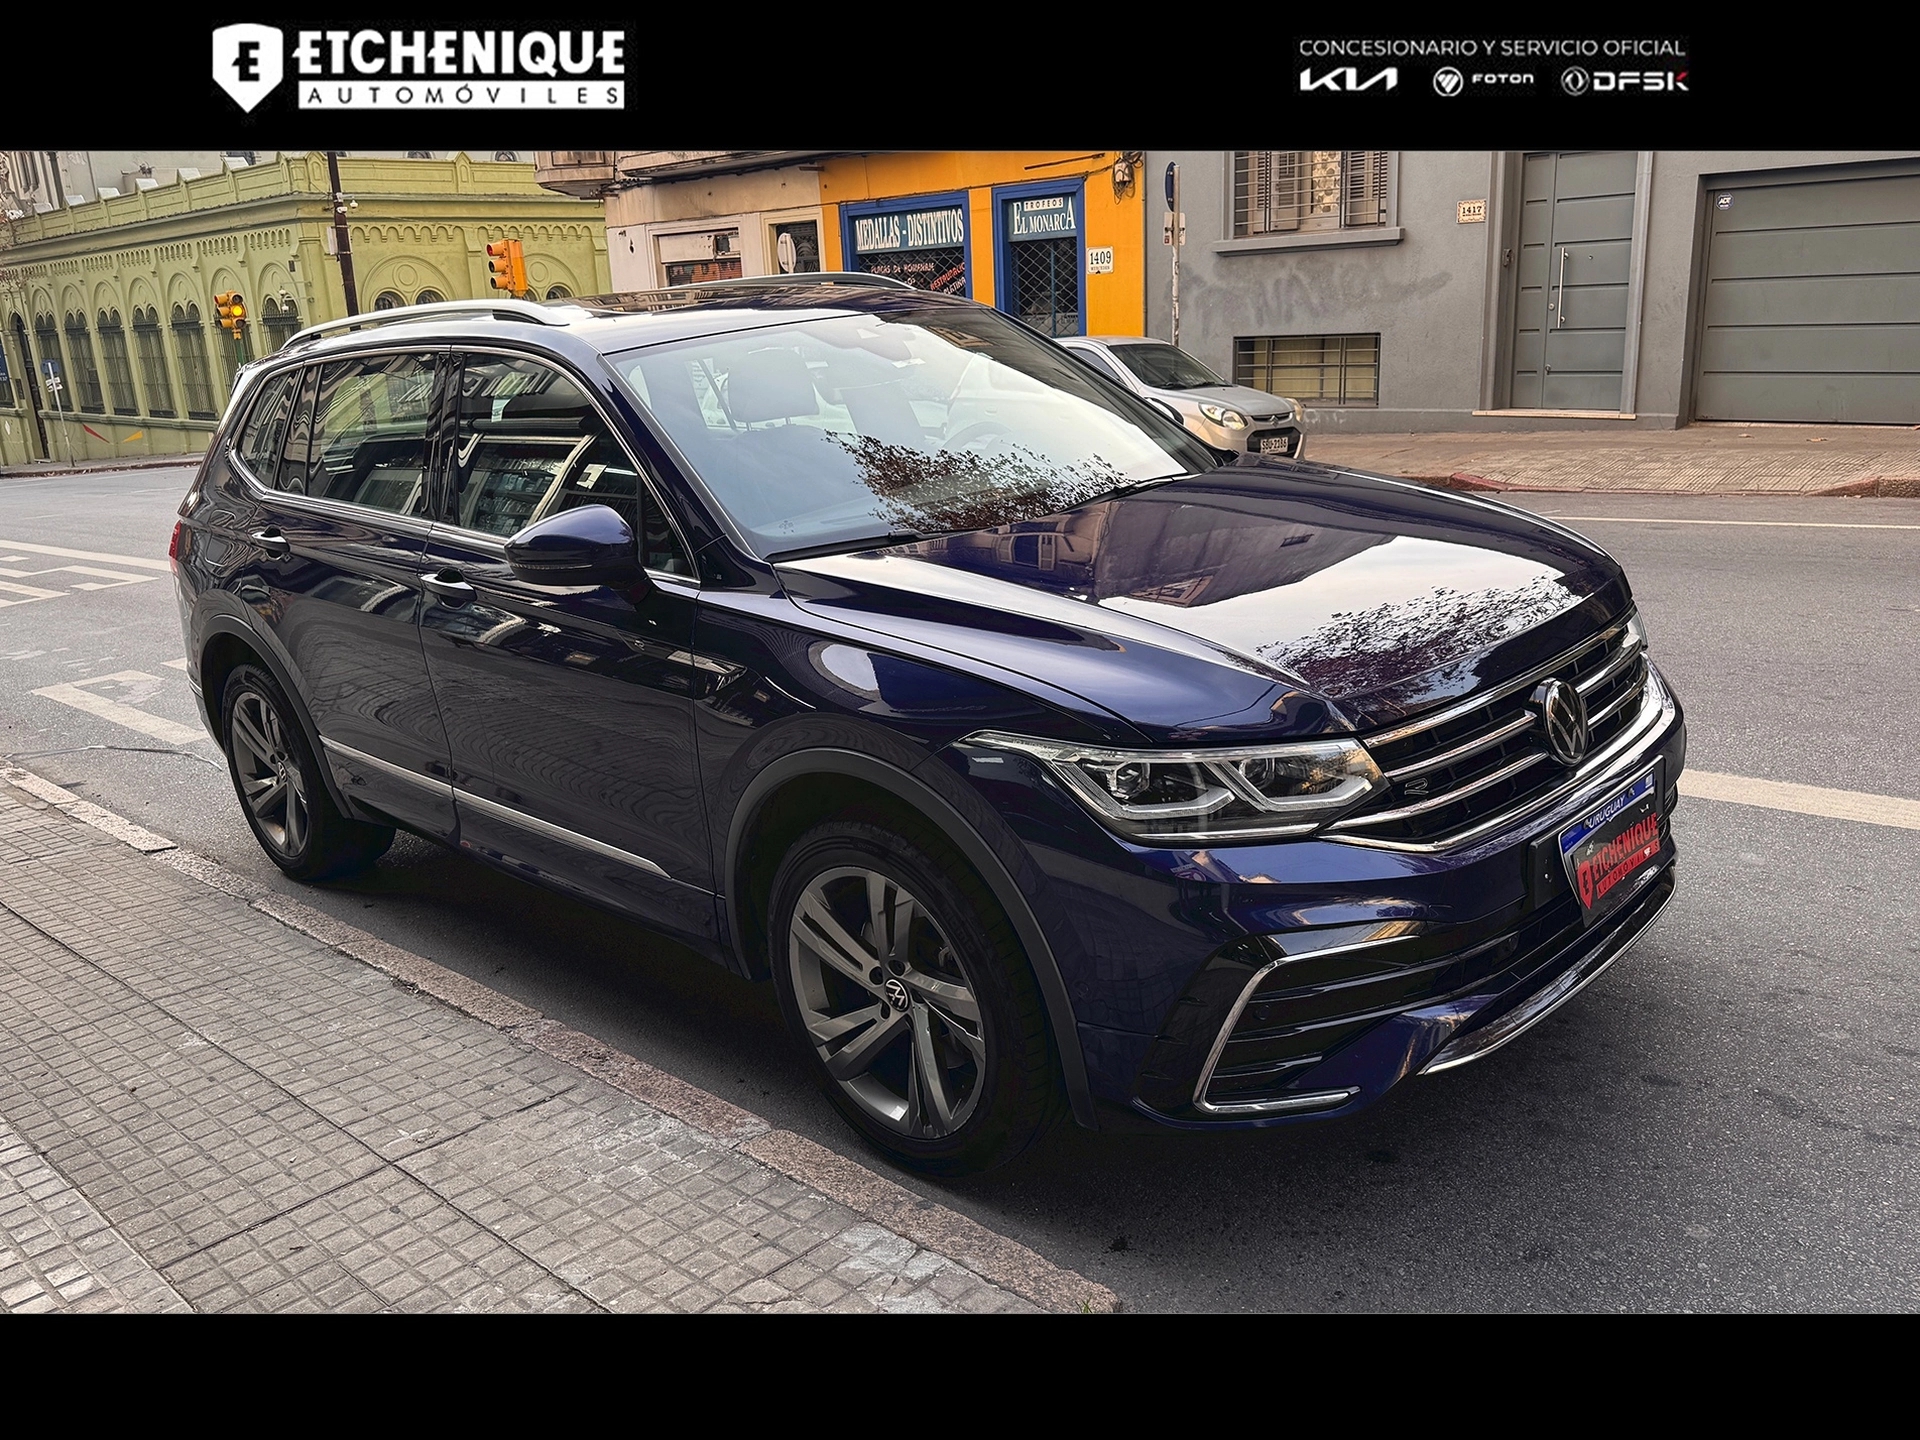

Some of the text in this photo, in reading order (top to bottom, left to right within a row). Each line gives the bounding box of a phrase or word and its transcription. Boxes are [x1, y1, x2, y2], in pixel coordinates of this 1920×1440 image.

[1025, 198, 1063, 211] TROFEOS
[1029, 197, 1077, 233] MONARCA
[1462, 205, 1482, 214] 1417
[855, 215, 901, 251] MEDALLAS
[907, 208, 965, 246] DISTINTIVOS
[1090, 251, 1112, 265] 1409
[1589, 793, 1626, 828] URUGUAY
[1592, 812, 1659, 880] ETCHENIQUE
